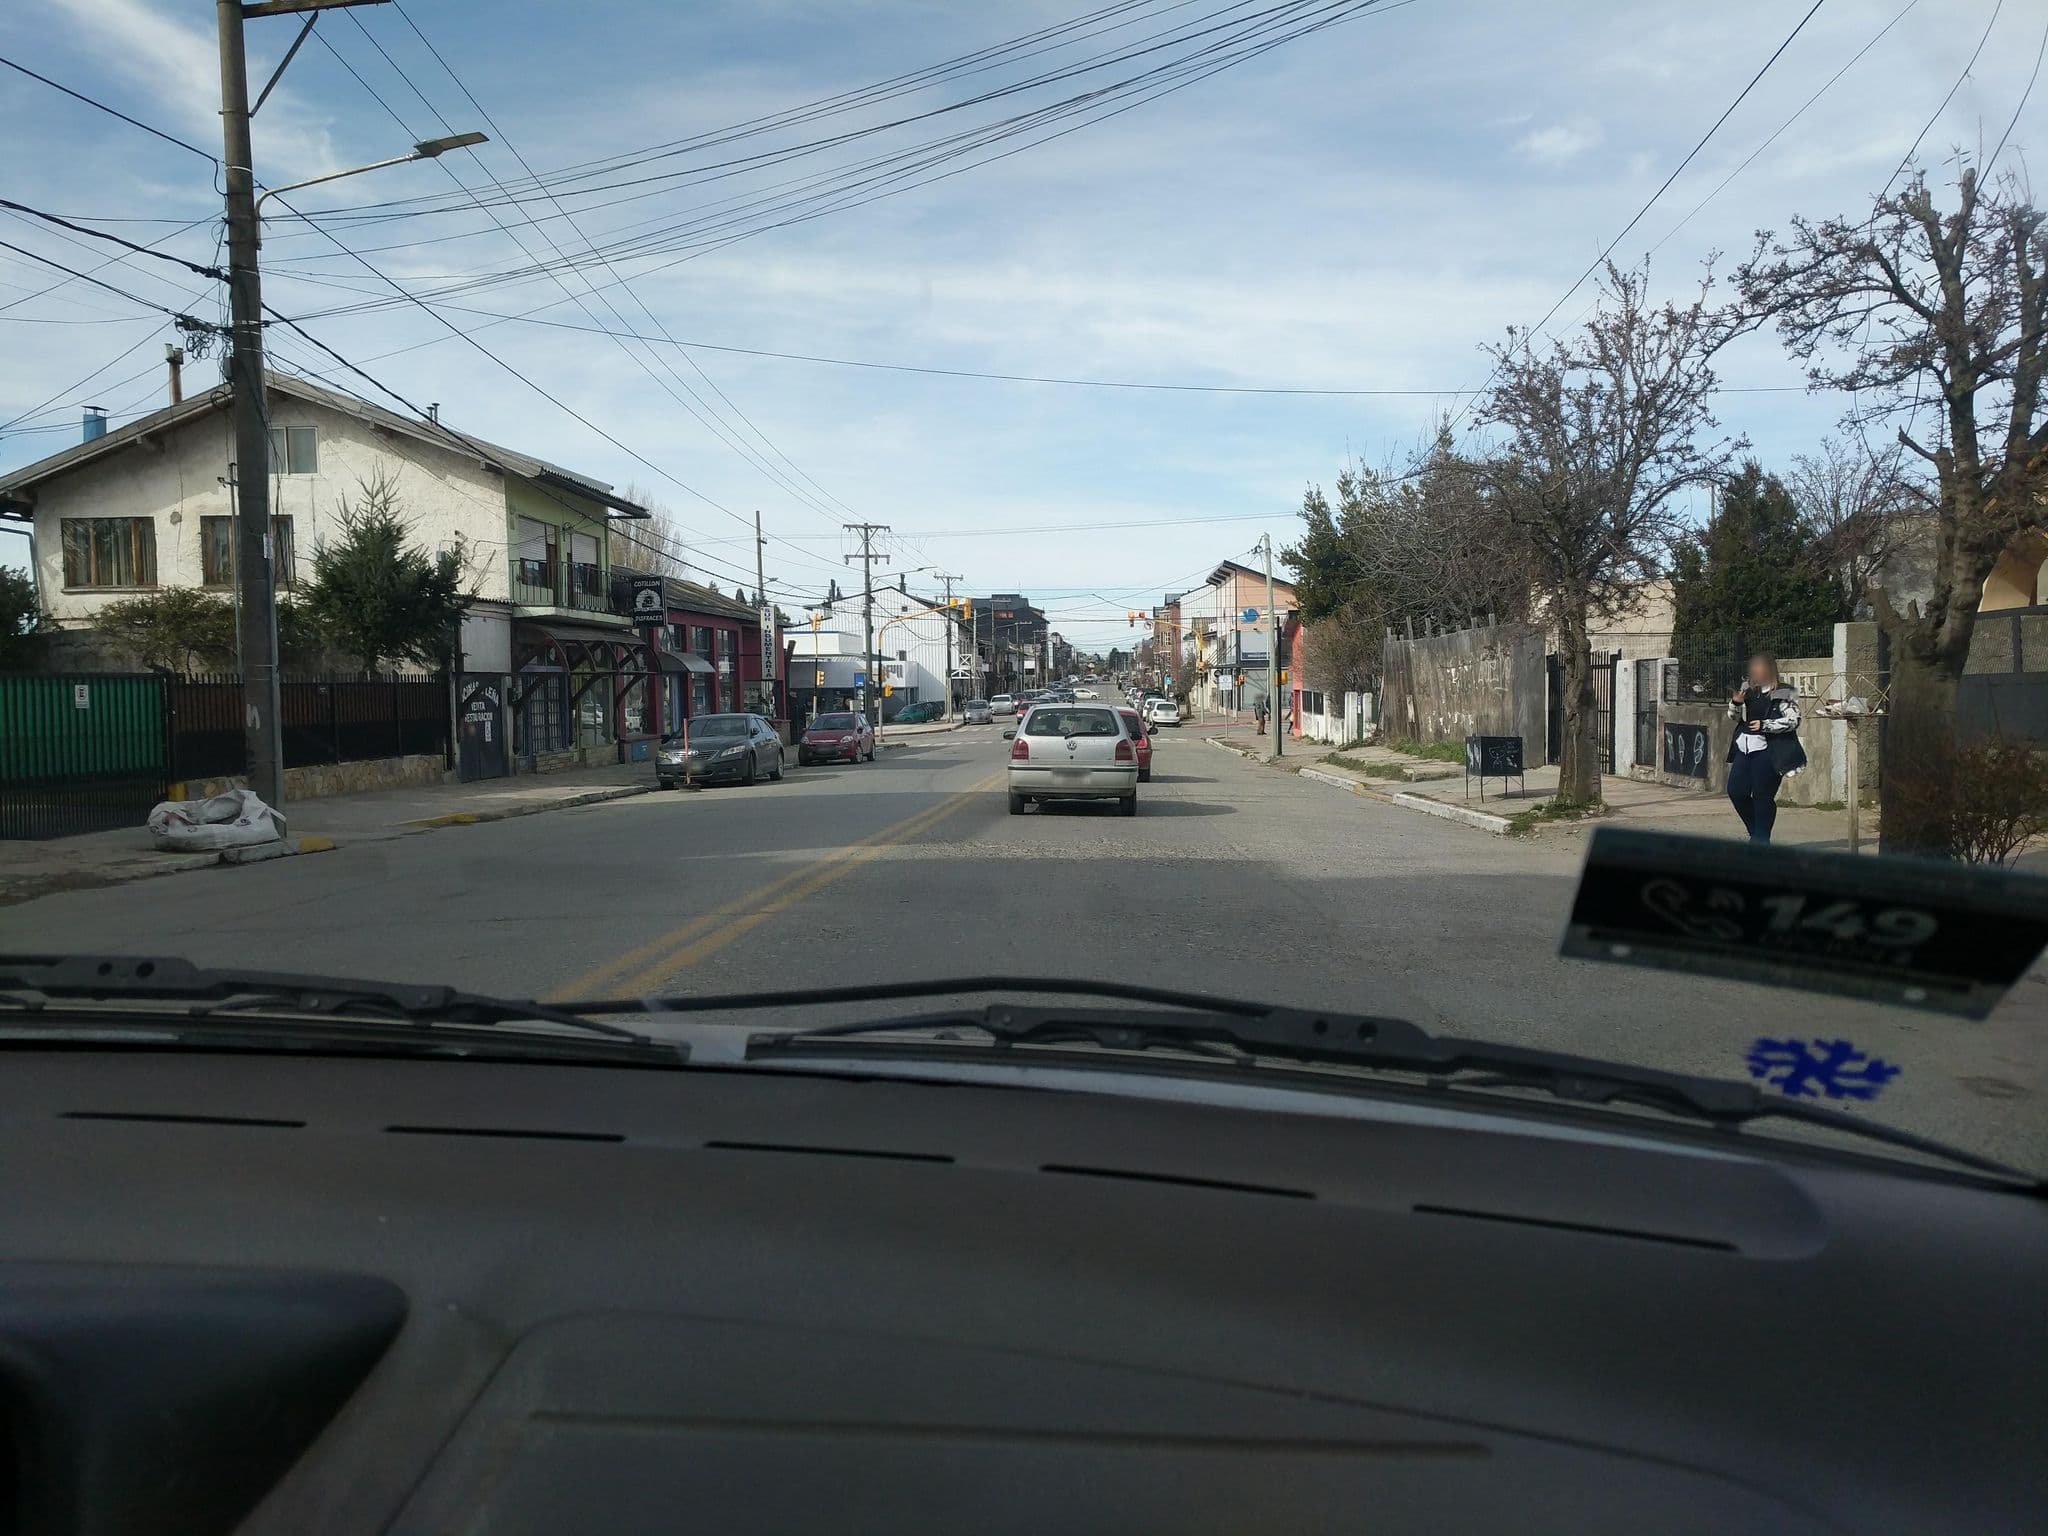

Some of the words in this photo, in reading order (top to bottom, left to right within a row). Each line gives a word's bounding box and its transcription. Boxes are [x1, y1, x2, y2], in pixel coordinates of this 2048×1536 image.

[634, 580, 661, 588] COTILLON
[634, 615, 663, 623] DISFRACES
[764, 624, 773, 678] INDUMENTARIA
